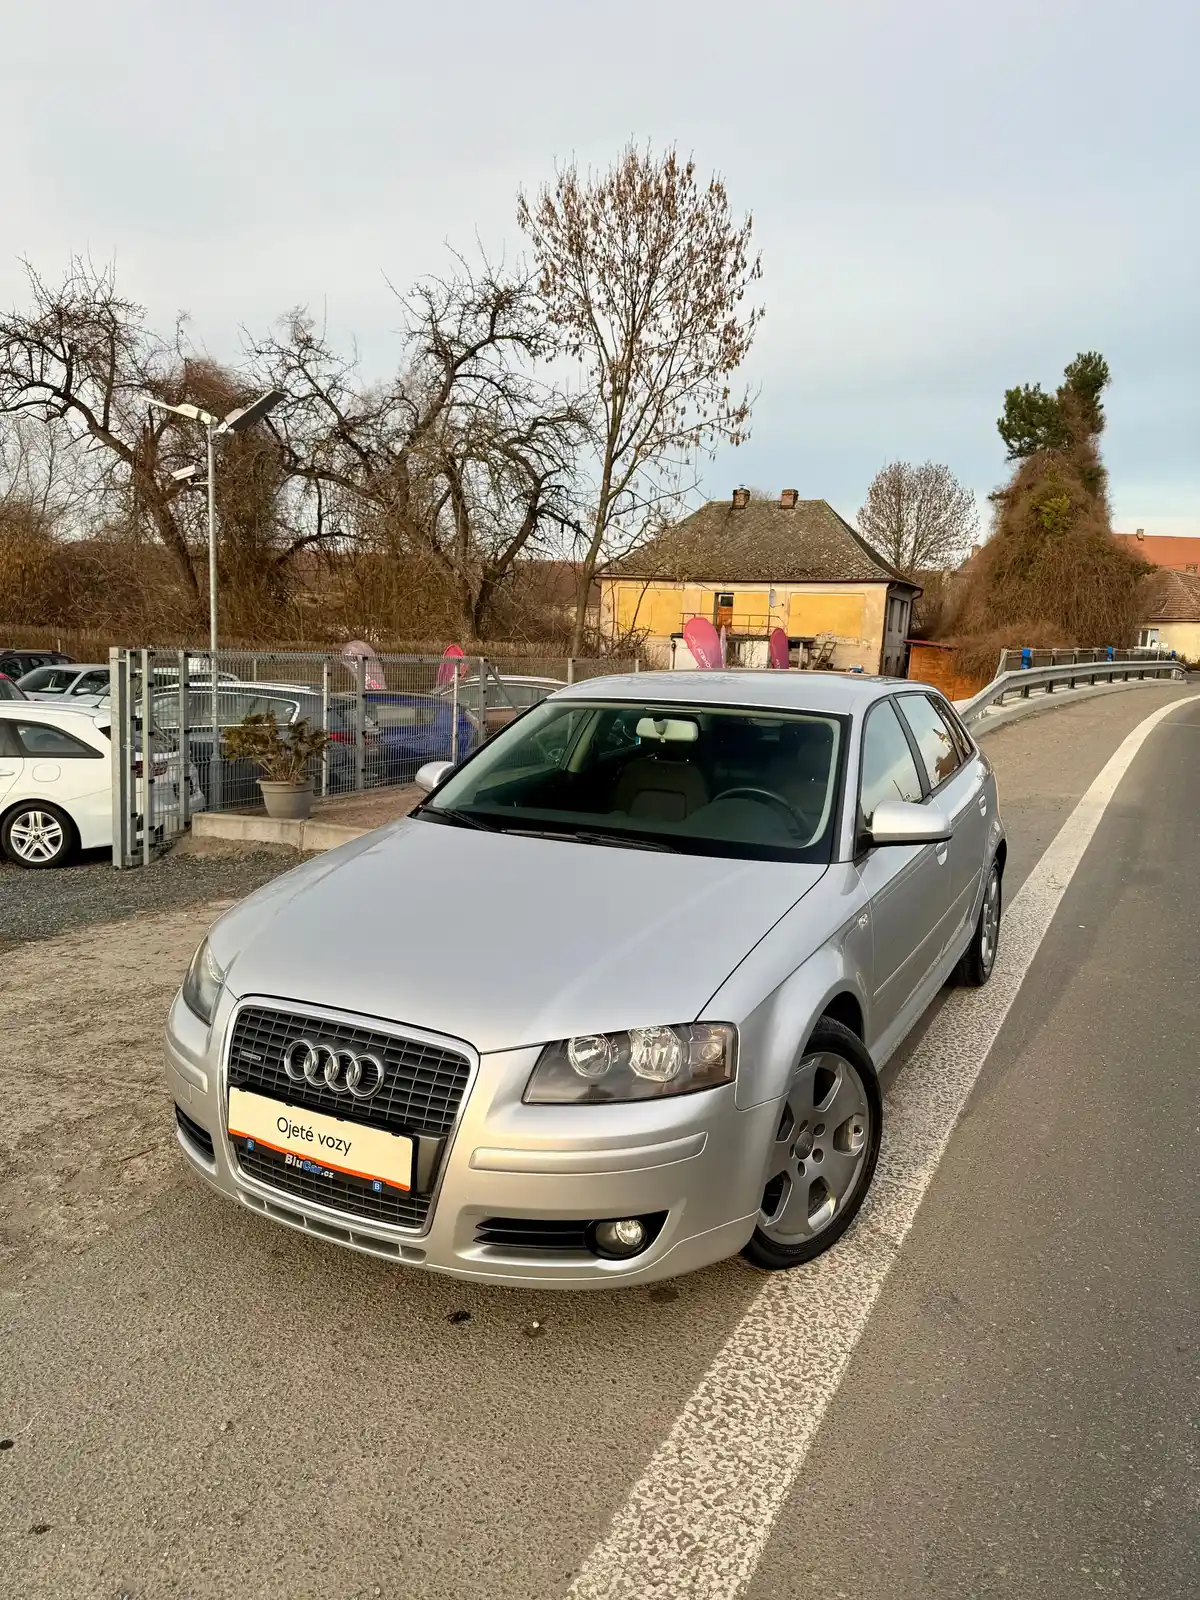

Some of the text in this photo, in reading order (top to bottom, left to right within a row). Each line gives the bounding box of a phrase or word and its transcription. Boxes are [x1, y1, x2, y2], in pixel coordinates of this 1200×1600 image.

[276, 1116, 352, 1157] Ojeté vozy
[284, 1153, 335, 1179] BluCar.cz
